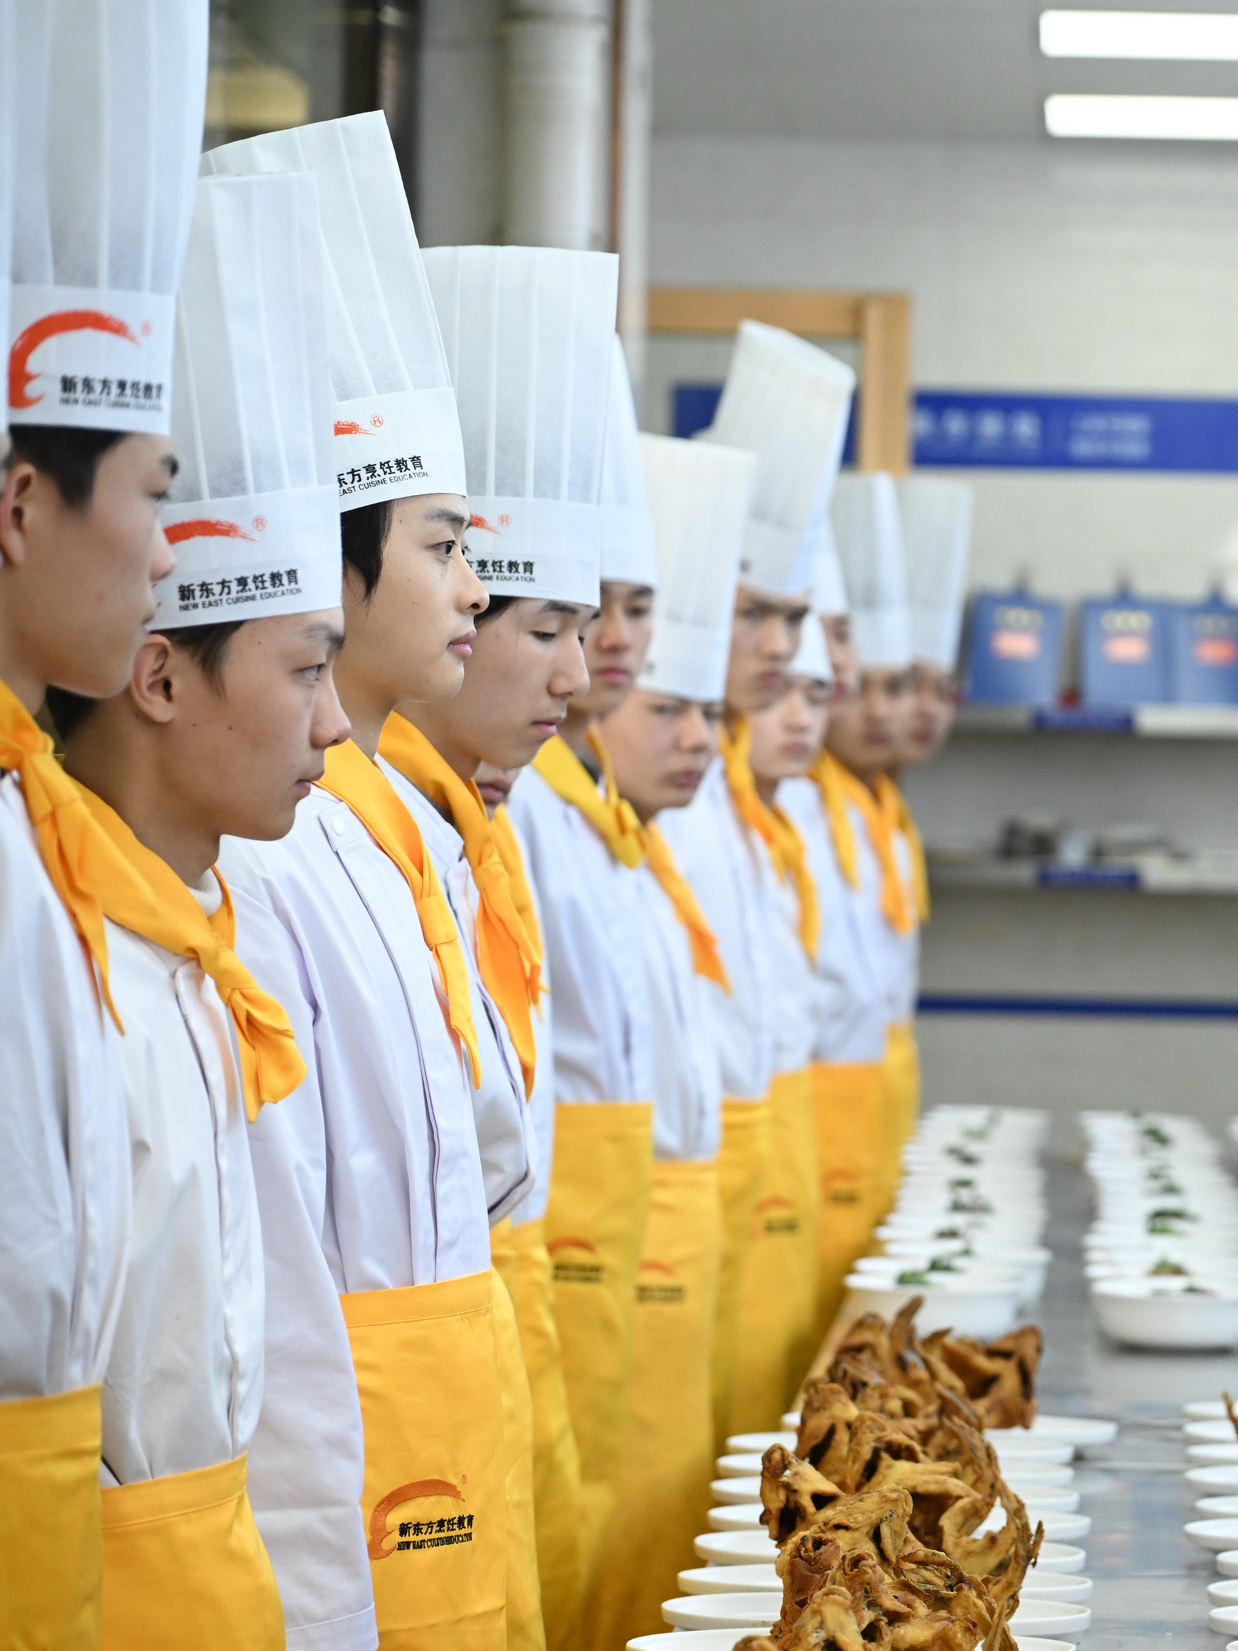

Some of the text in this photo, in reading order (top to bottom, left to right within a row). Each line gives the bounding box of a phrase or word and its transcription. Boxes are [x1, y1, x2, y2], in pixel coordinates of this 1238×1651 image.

[358, 478, 388, 491] CUISINE
[389, 471, 429, 484] EDUCATION
[177, 568, 299, 602] 新东方烹饪教育
[178, 587, 303, 612] NEW EAST CUISINE EDUCATION
[398, 1513, 475, 1538] 新东方烹饪教育
